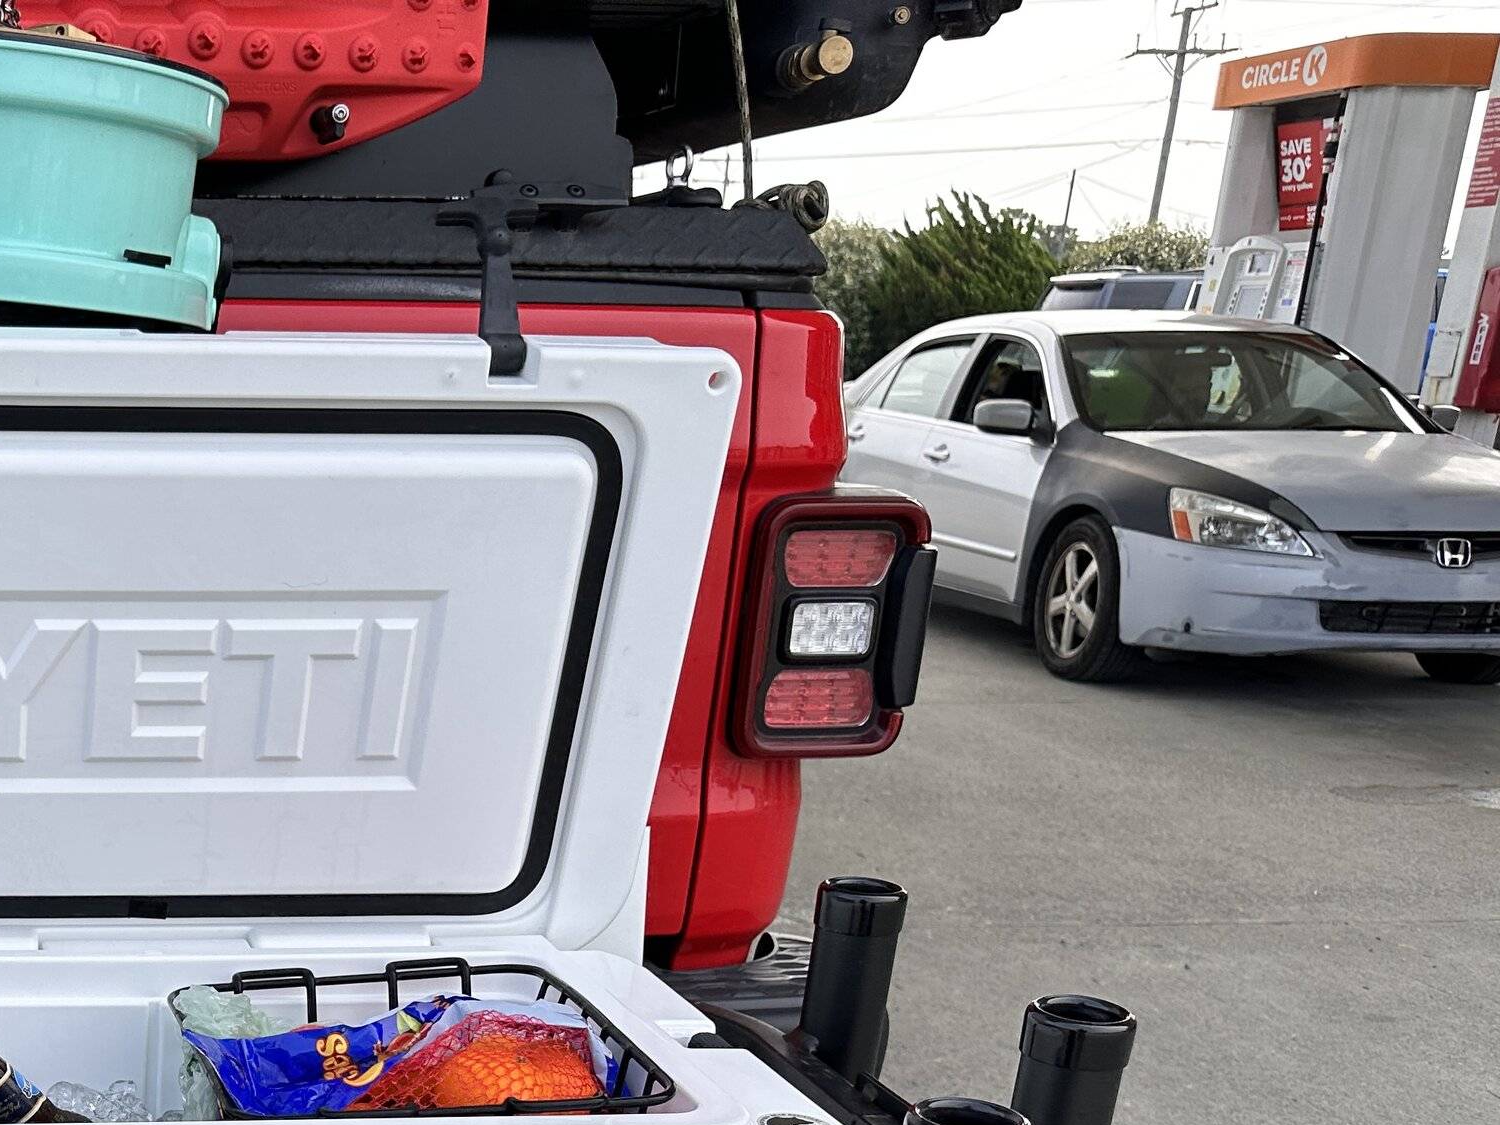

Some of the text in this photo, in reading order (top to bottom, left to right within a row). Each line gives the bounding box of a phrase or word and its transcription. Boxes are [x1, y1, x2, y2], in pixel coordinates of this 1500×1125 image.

[1241, 45, 1328, 90] CIRCLE K
[1280, 137, 1312, 157] SAVE
